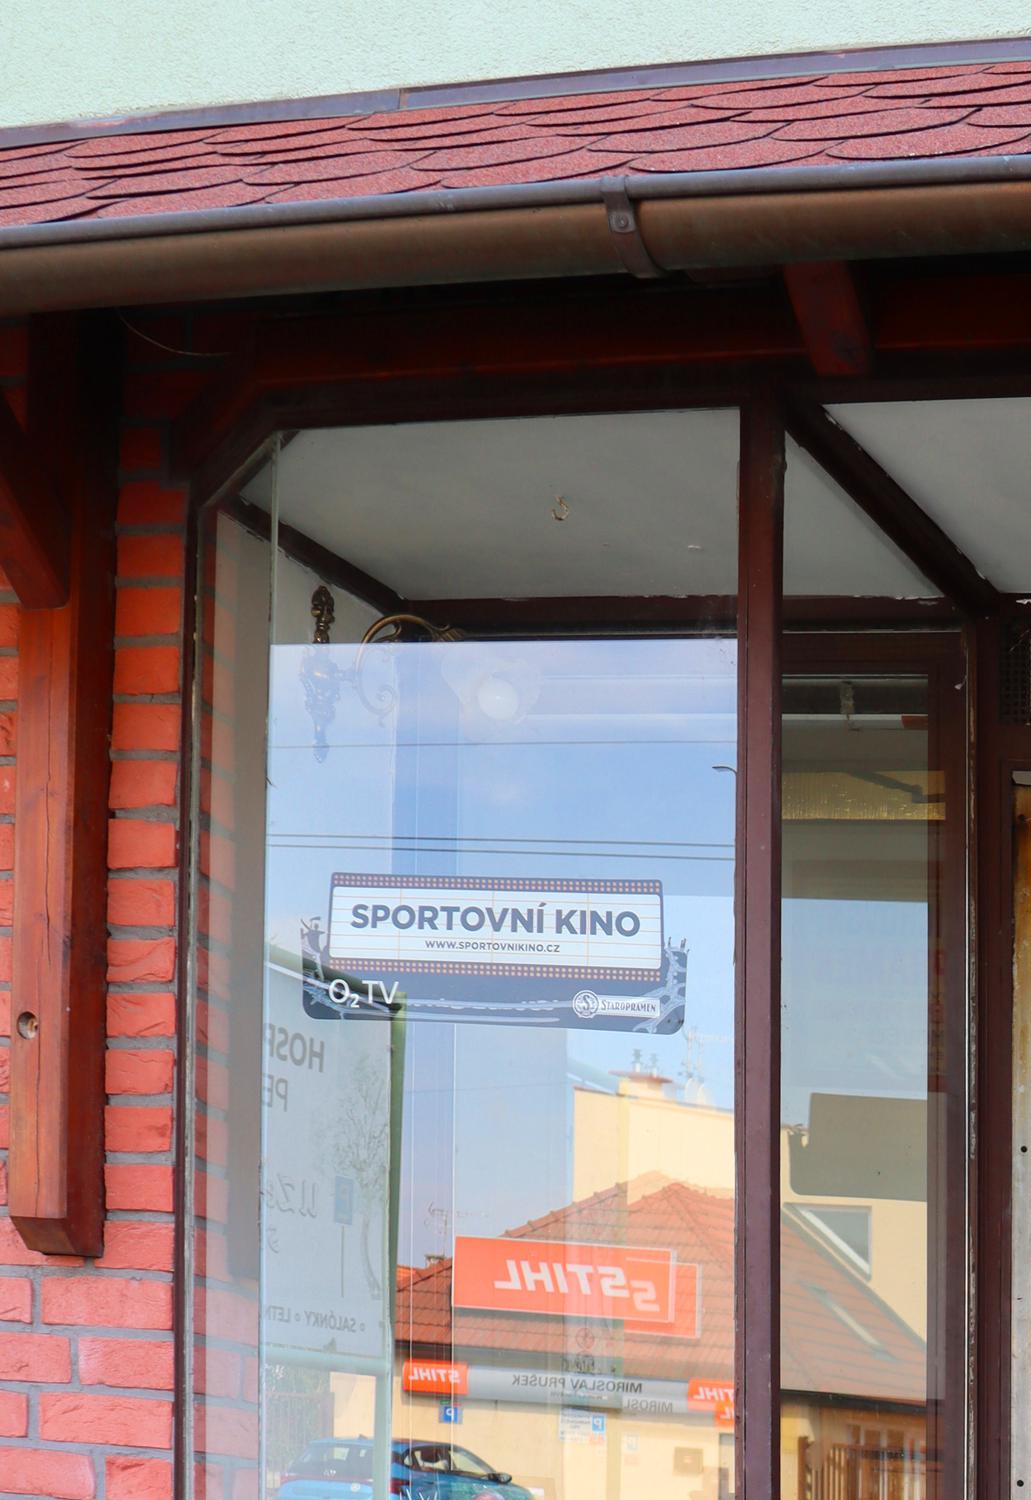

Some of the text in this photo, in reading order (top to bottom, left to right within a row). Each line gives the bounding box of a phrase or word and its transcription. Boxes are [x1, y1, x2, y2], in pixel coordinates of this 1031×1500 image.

[350, 902, 641, 938] SPORTOVNÍ KINO
[425, 940, 560, 953] WWW.SPORTOVNIKINO.CZ
[362, 980, 400, 1005] TV
